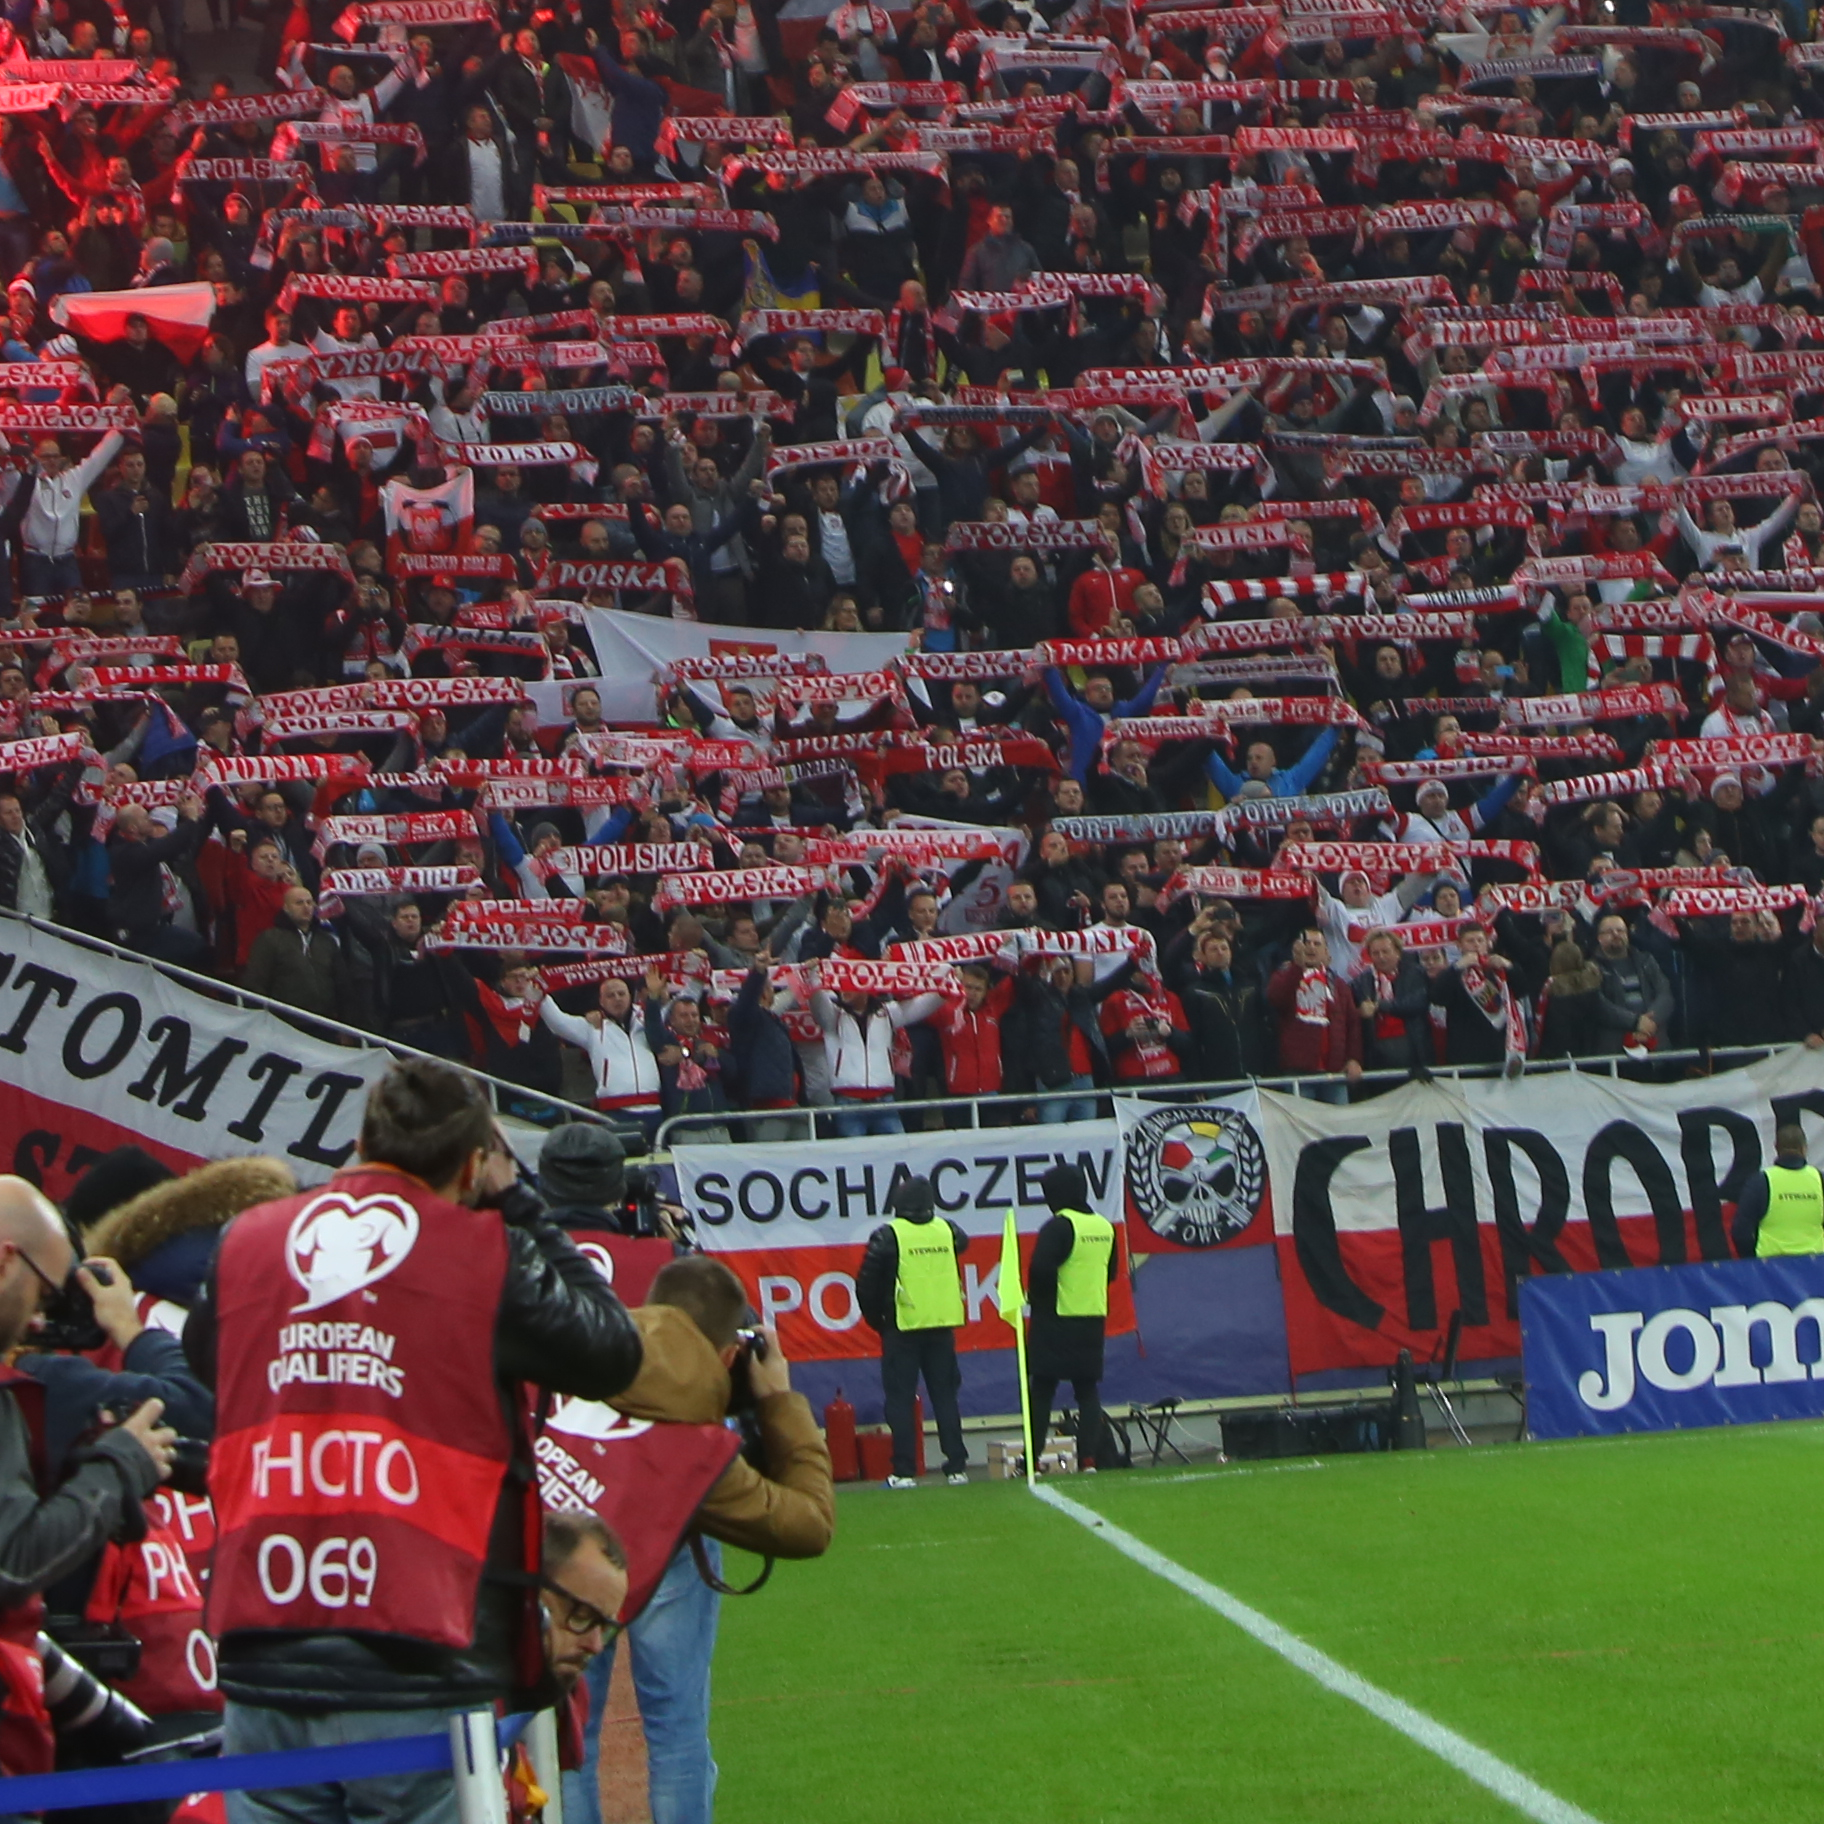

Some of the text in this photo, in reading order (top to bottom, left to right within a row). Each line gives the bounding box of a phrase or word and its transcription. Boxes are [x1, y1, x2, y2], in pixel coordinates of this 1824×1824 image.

[679, 119, 778, 141] POLSKA
[424, 249, 534, 272] POLSKA
[305, 274, 416, 302] POLSKA
[475, 445, 573, 463] POLSKA
[1349, 449, 1471, 473] POLSKA
[1417, 507, 1527, 524] POLSKA
[972, 521, 1095, 547] POLSKA
[214, 543, 328, 569] POLSKA
[560, 563, 667, 588] POLSKA
[433, 626, 536, 649] Polska
[1339, 615, 1459, 639] POLSKA
[1062, 641, 1164, 662] POLSKA
[683, 655, 793, 678] POLSKA
[379, 677, 516, 706] POLSKA
[1534, 691, 1648, 718] POL SKA
[278, 712, 396, 731] POLSKA
[926, 743, 1004, 769] POLSKA
[502, 781, 617, 801] POL SKA
[339, 816, 457, 836] POL SKA
[579, 843, 697, 871] POLSKA
[690, 867, 805, 899] POLSKA
[481, 899, 577, 916] POLSKA
[831, 961, 957, 992] POLSKA
[694, 1148, 1114, 1226] SOCHACZEW
[1778, 1193, 1818, 1202] STEWARD
[908, 1246, 949, 1256] STEWARD
[534, 1436, 606, 1503] OPEAN
[258, 1534, 377, 1607] 069
